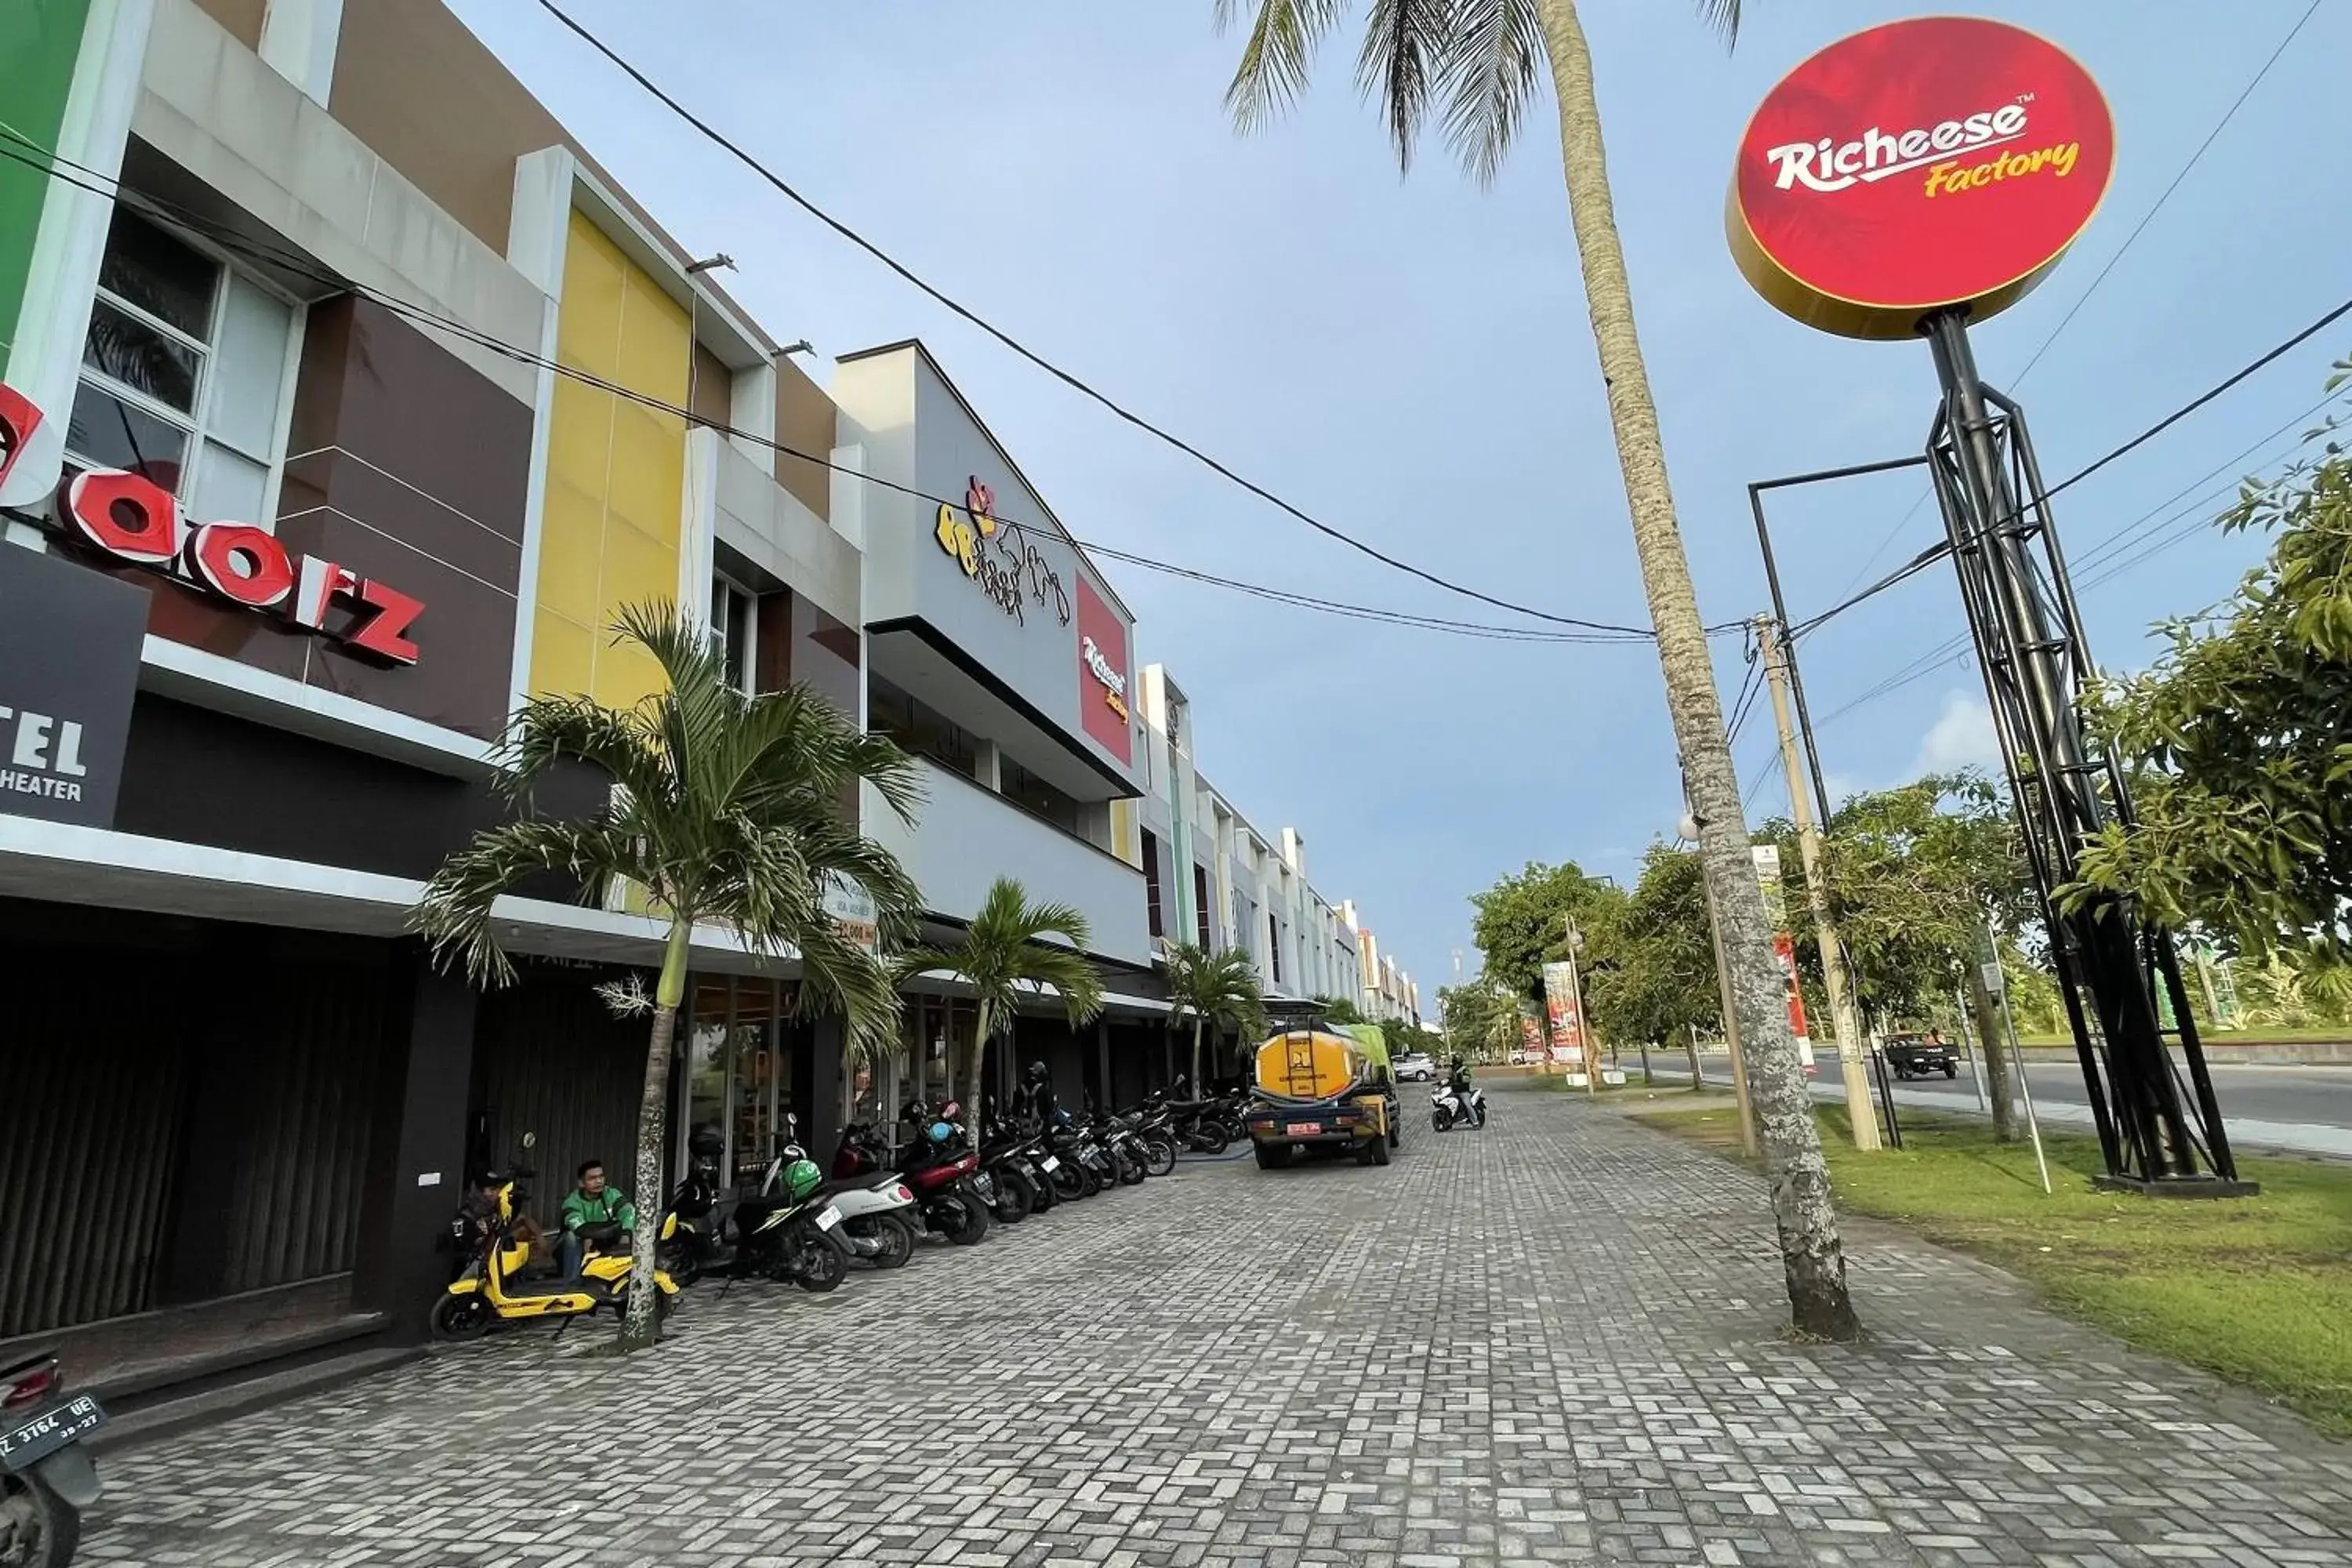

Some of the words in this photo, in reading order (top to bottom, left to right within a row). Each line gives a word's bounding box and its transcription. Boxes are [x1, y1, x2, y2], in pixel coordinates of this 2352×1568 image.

[1766, 103, 2027, 192] Richeese
[1924, 142, 2080, 198] Factory
[70, 1399, 92, 1417] UE
